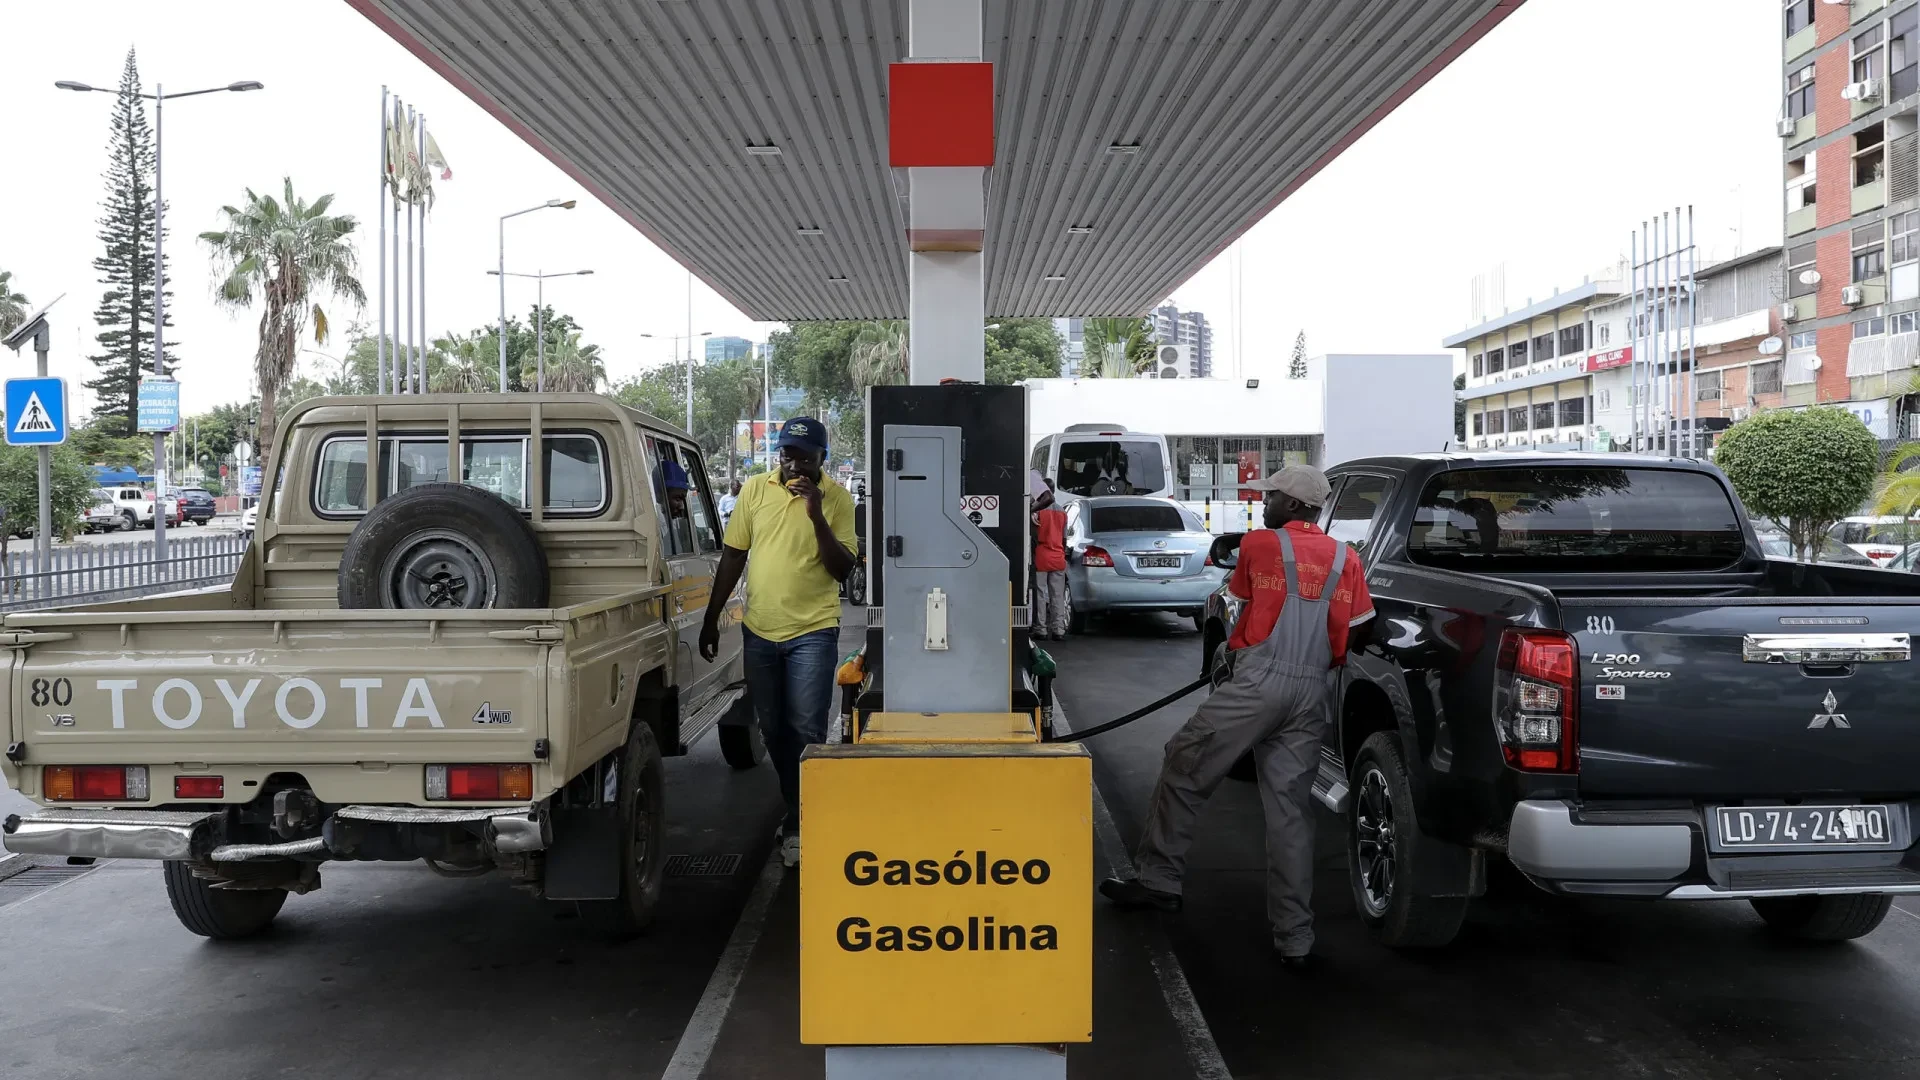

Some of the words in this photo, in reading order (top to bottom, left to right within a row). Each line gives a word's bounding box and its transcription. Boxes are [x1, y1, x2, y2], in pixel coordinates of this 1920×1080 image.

[1586, 615, 1615, 635] 80
[1591, 652, 1641, 665] L200
[1596, 667, 1672, 682] Sportero
[31, 677, 73, 707] 80
[97, 677, 446, 730] TOYOTA
[472, 701, 512, 724] 4WD
[1723, 809, 1884, 842] LD-74-24HQ
[844, 850, 1051, 886] Gasóleo
[836, 916, 1058, 952] Gasolina
